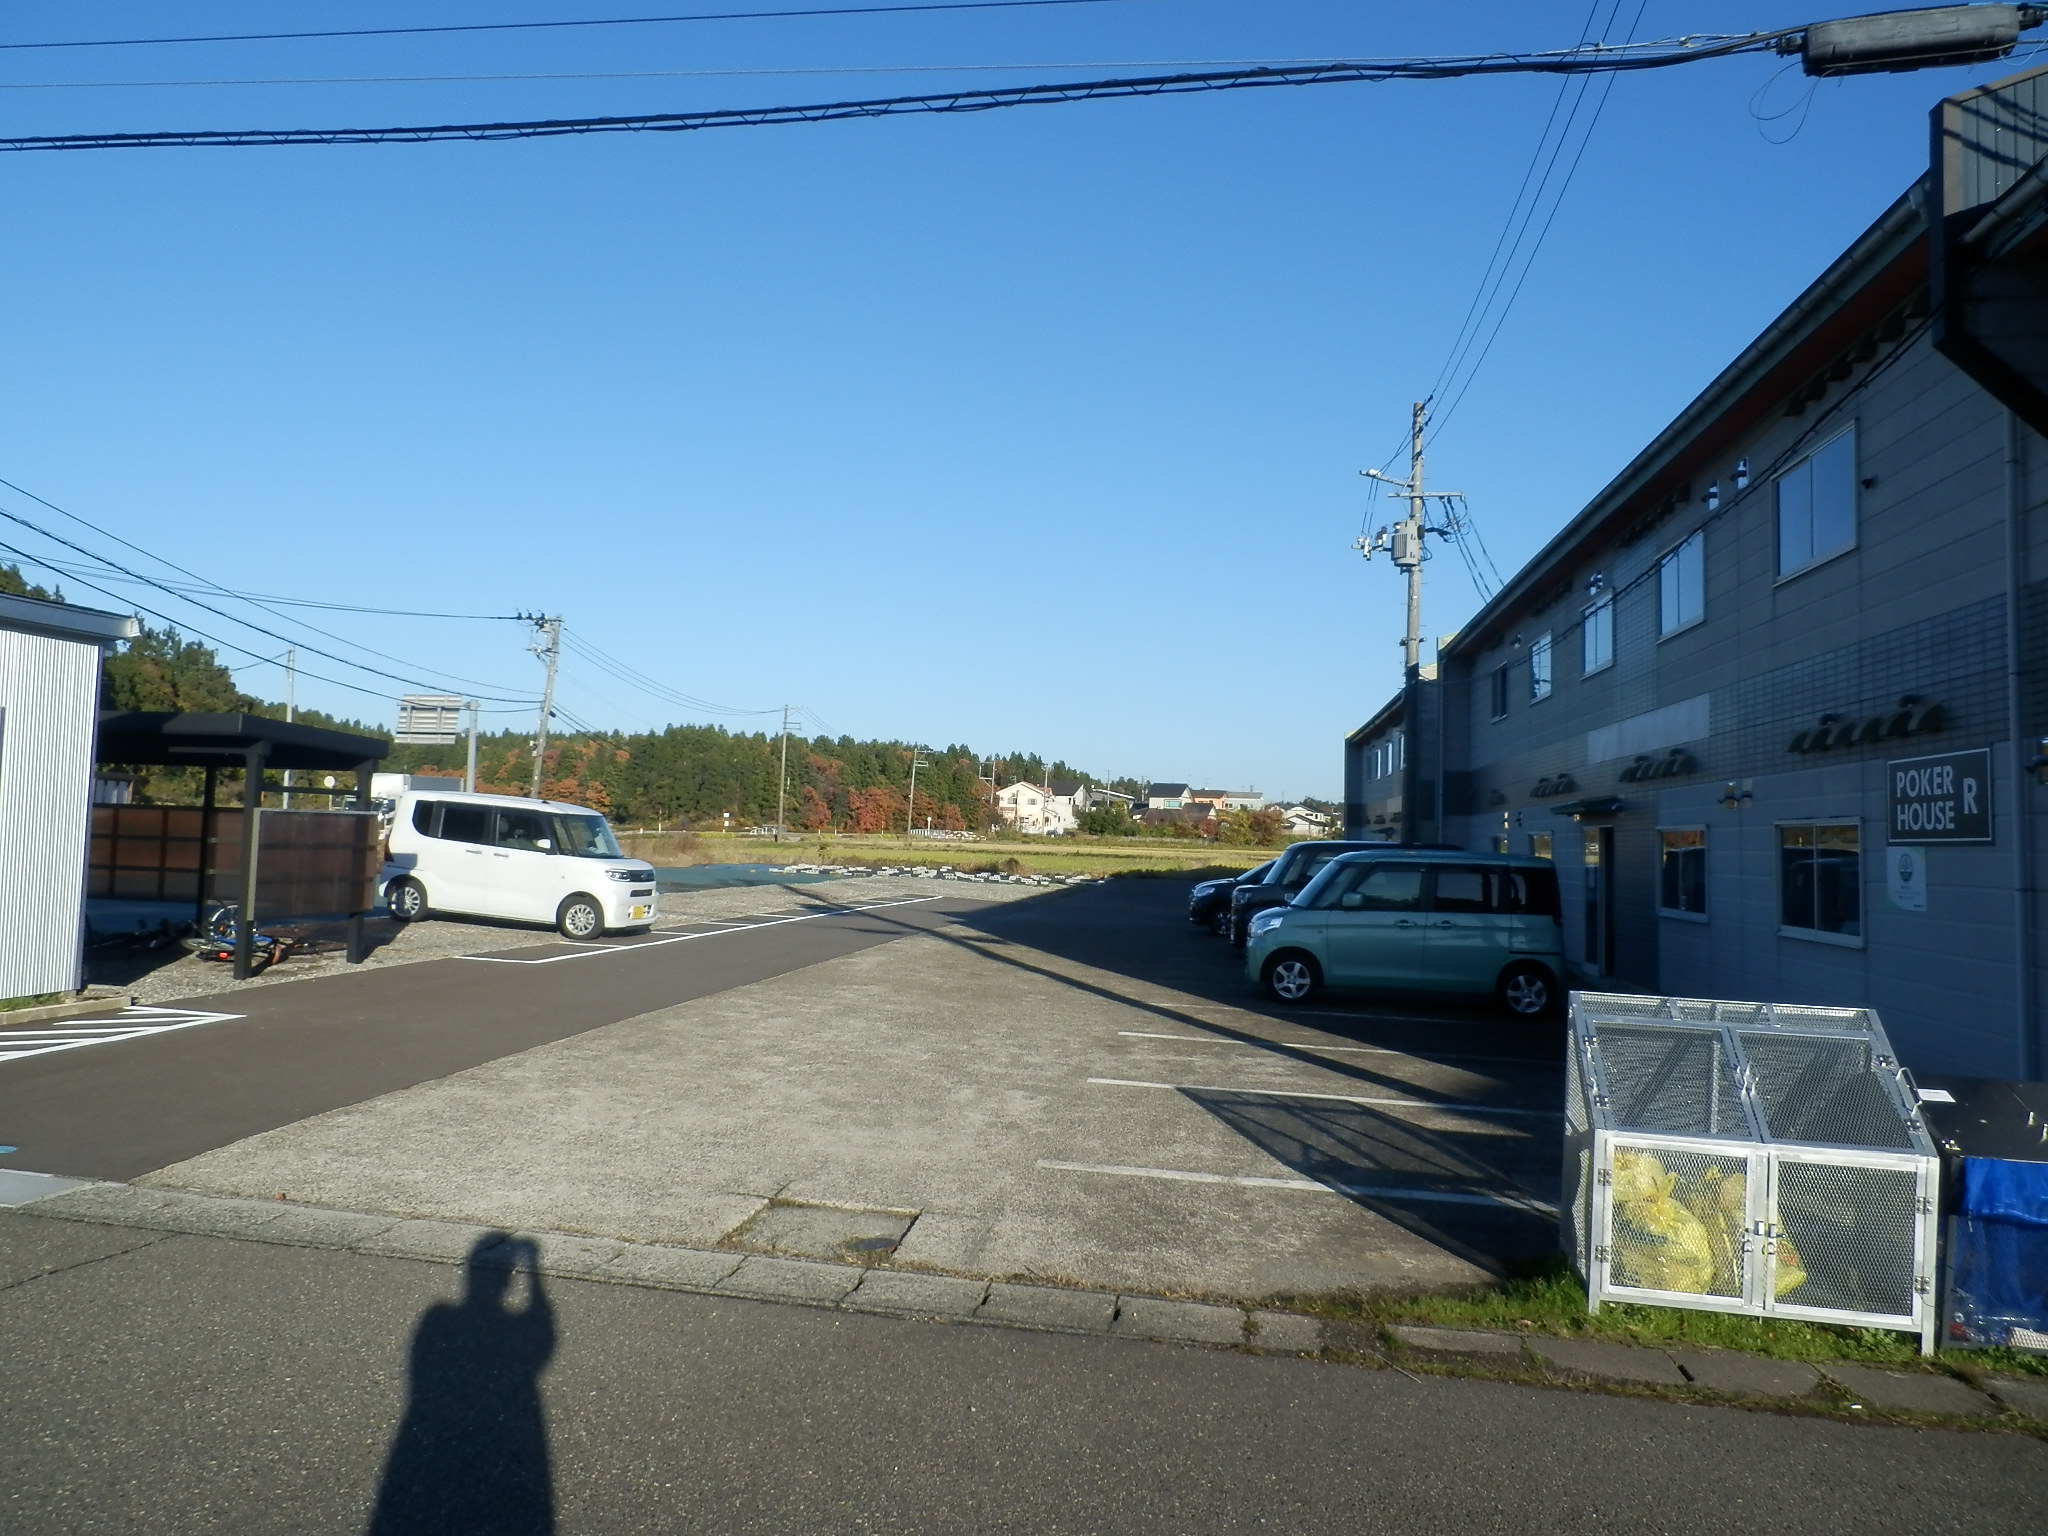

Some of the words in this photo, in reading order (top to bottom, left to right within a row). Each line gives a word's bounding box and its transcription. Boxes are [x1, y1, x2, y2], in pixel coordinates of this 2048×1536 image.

[1896, 765, 1955, 798] POKER
[1963, 777, 1979, 814] R
[1897, 800, 1956, 831] HOUSE
